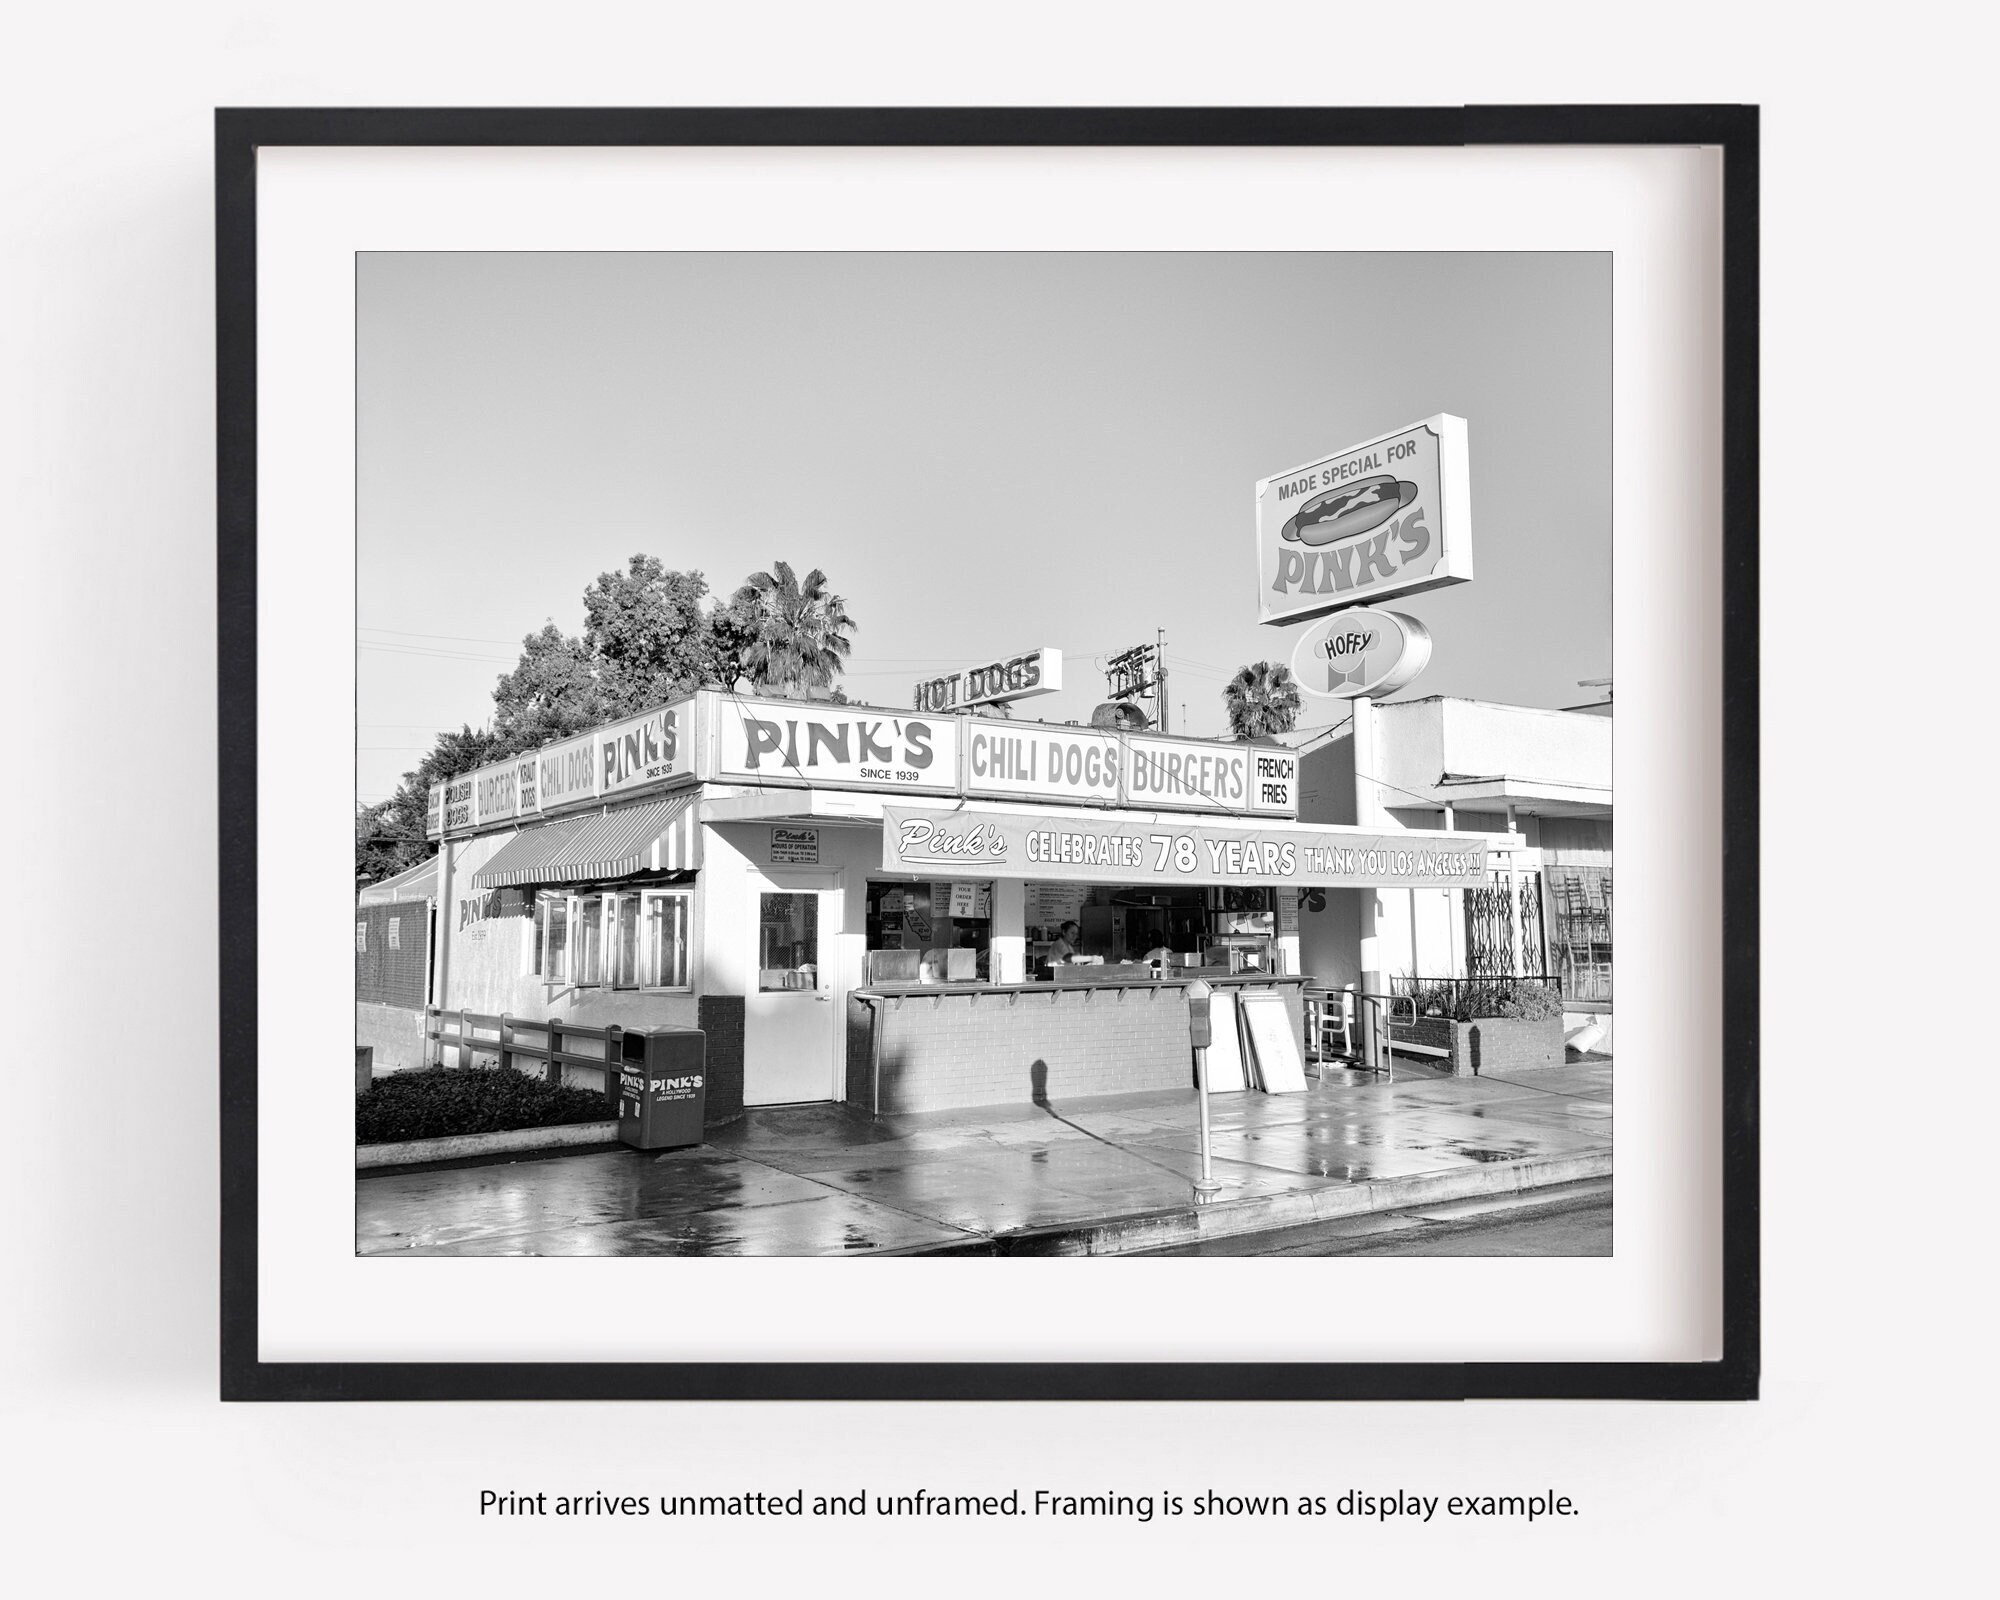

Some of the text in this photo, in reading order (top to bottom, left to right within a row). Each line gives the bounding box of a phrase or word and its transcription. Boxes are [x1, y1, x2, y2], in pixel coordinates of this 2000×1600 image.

[1278, 439, 1417, 501] MADE SPECIAL FOR
[1272, 506, 1430, 594] PINK'S
[1324, 632, 1371, 660] HOFFY
[913, 653, 1040, 713] HOT DOGS
[603, 710, 677, 790] PINK'S
[744, 717, 933, 769] PINK'S
[971, 733, 1118, 788] CHILI DOGS
[541, 744, 593, 798] CHILI DOGS
[646, 763, 673, 778] SINCE 1939
[860, 768, 919, 781] SINCE 1939
[1133, 750, 1243, 799] BURGERS
[1257, 757, 1294, 780] FRENCH
[445, 781, 471, 804] POLISH
[478, 770, 516, 816] BURGERS
[521, 787, 536, 808] DOGS
[1262, 783, 1287, 804] FRIES
[447, 805, 468, 826] DOGS
[899, 818, 1007, 855] Pink's
[1025, 830, 1143, 867] CELEBRATES
[1150, 834, 1198, 873] 78
[1204, 839, 1296, 876] YEARS
[1304, 846, 1355, 875] THANK
[1358, 848, 1387, 875] YOU
[1390, 850, 1413, 876] LOS
[1417, 850, 1467, 876] ANGELES
[620, 1072, 645, 1091] PINK'S
[650, 1075, 703, 1092] PINK'S
